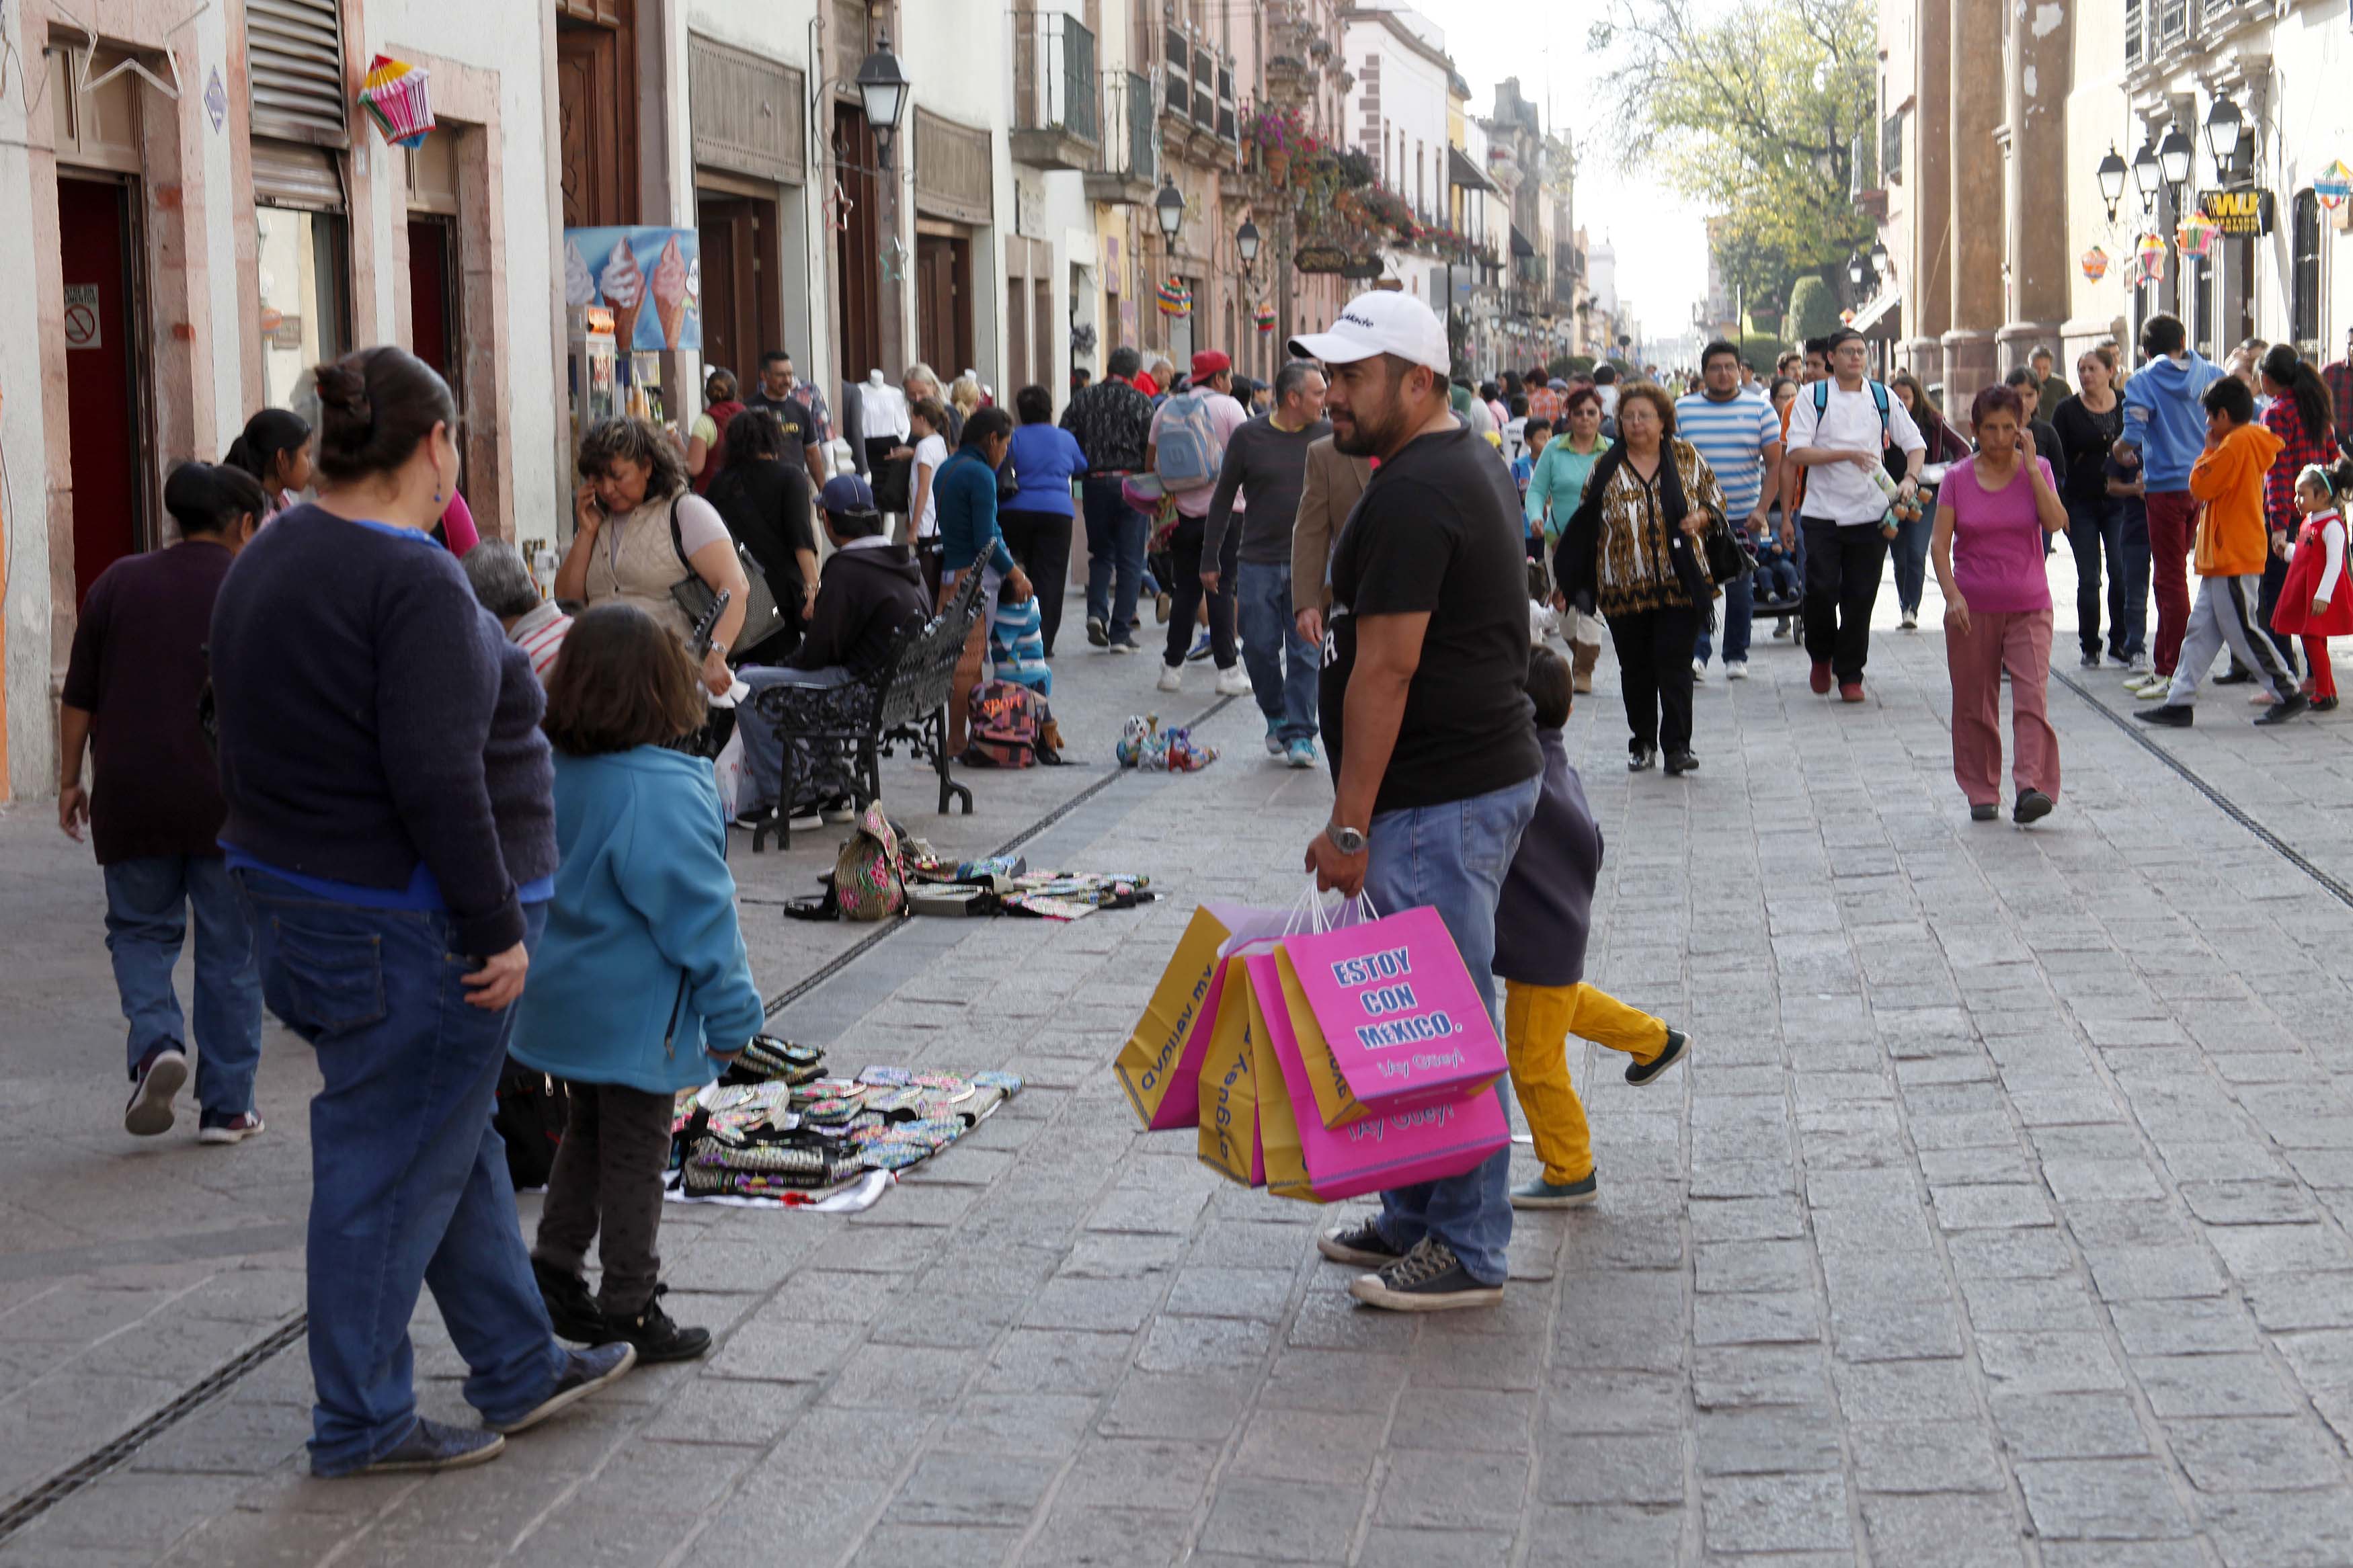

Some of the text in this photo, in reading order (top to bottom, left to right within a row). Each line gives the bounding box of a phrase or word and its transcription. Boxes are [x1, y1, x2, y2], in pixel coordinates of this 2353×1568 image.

[2216, 192, 2258, 216] WU
[1511, 440, 1522, 458] 7
[984, 694, 1022, 718] sport
[1330, 946, 1411, 988] ESTOY
[1360, 981, 1418, 1017] CON
